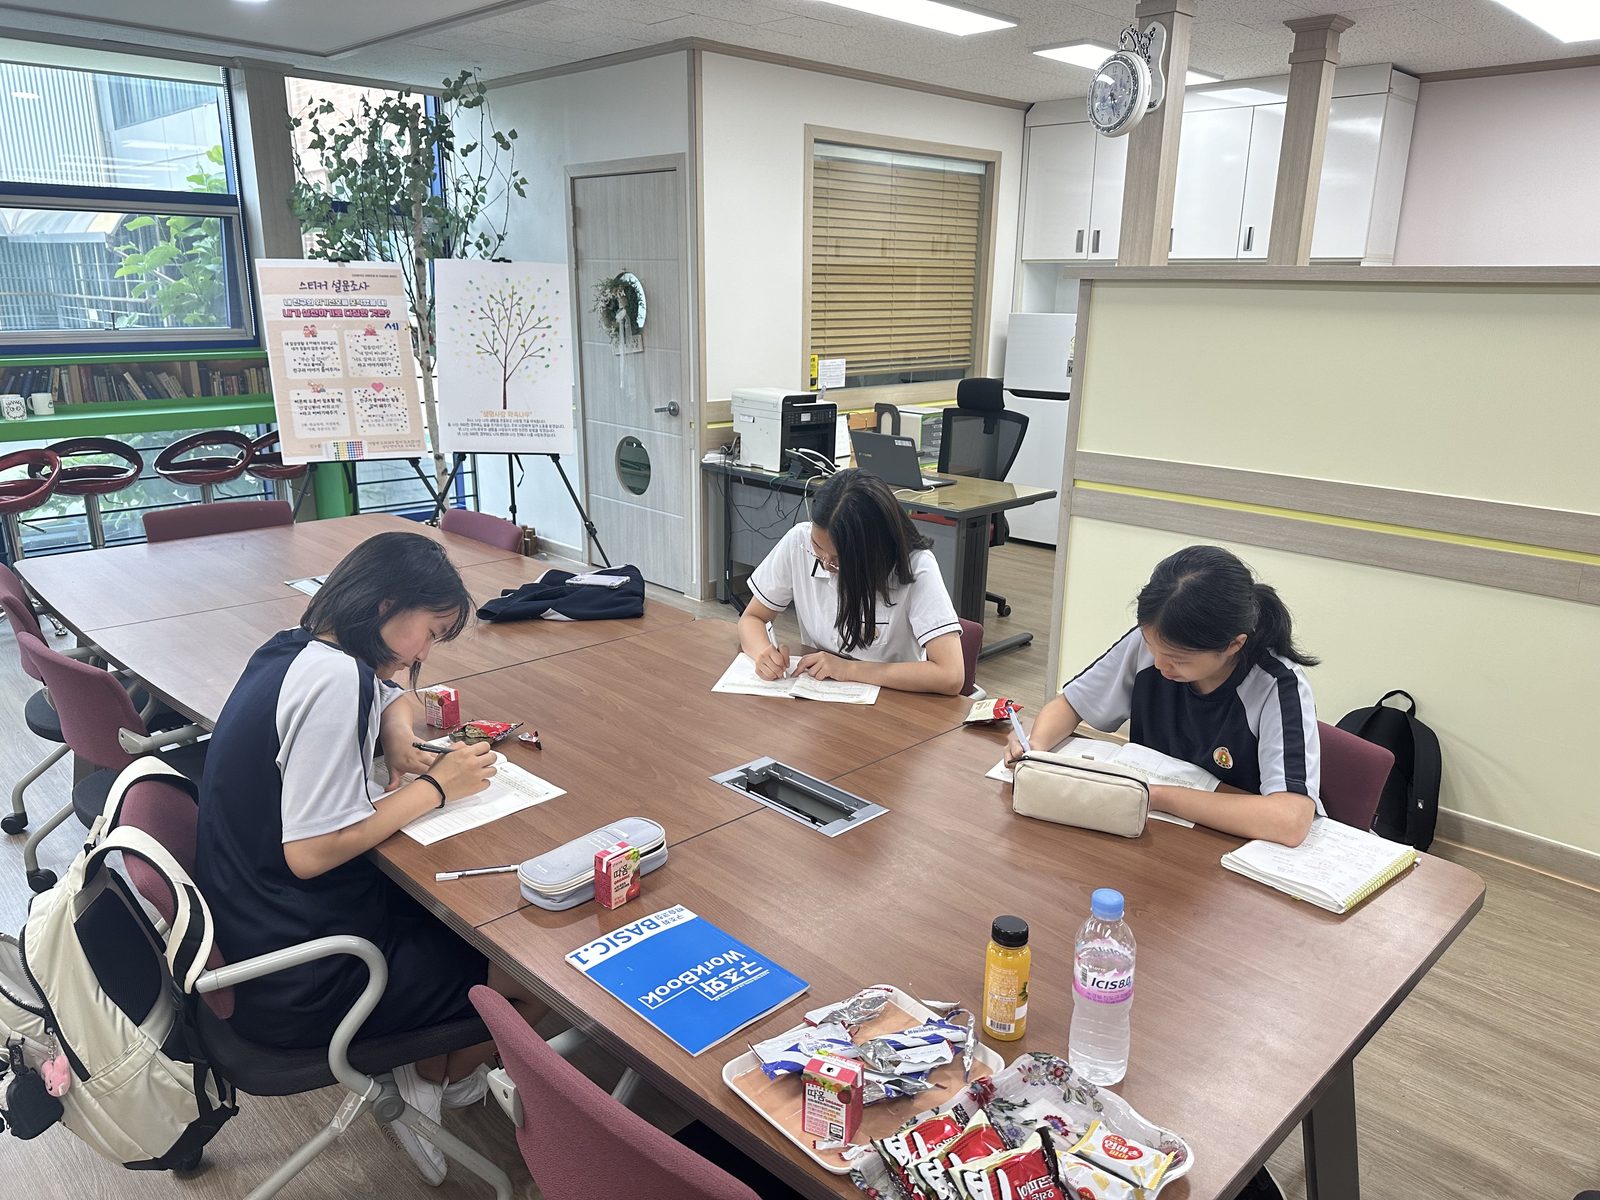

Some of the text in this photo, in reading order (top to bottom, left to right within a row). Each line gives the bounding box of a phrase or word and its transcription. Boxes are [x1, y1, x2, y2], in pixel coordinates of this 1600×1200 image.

[299, 280, 328, 290] 스티커
[641, 950, 746, 1004] WorkBook
[699, 961, 763, 995] 구조화
